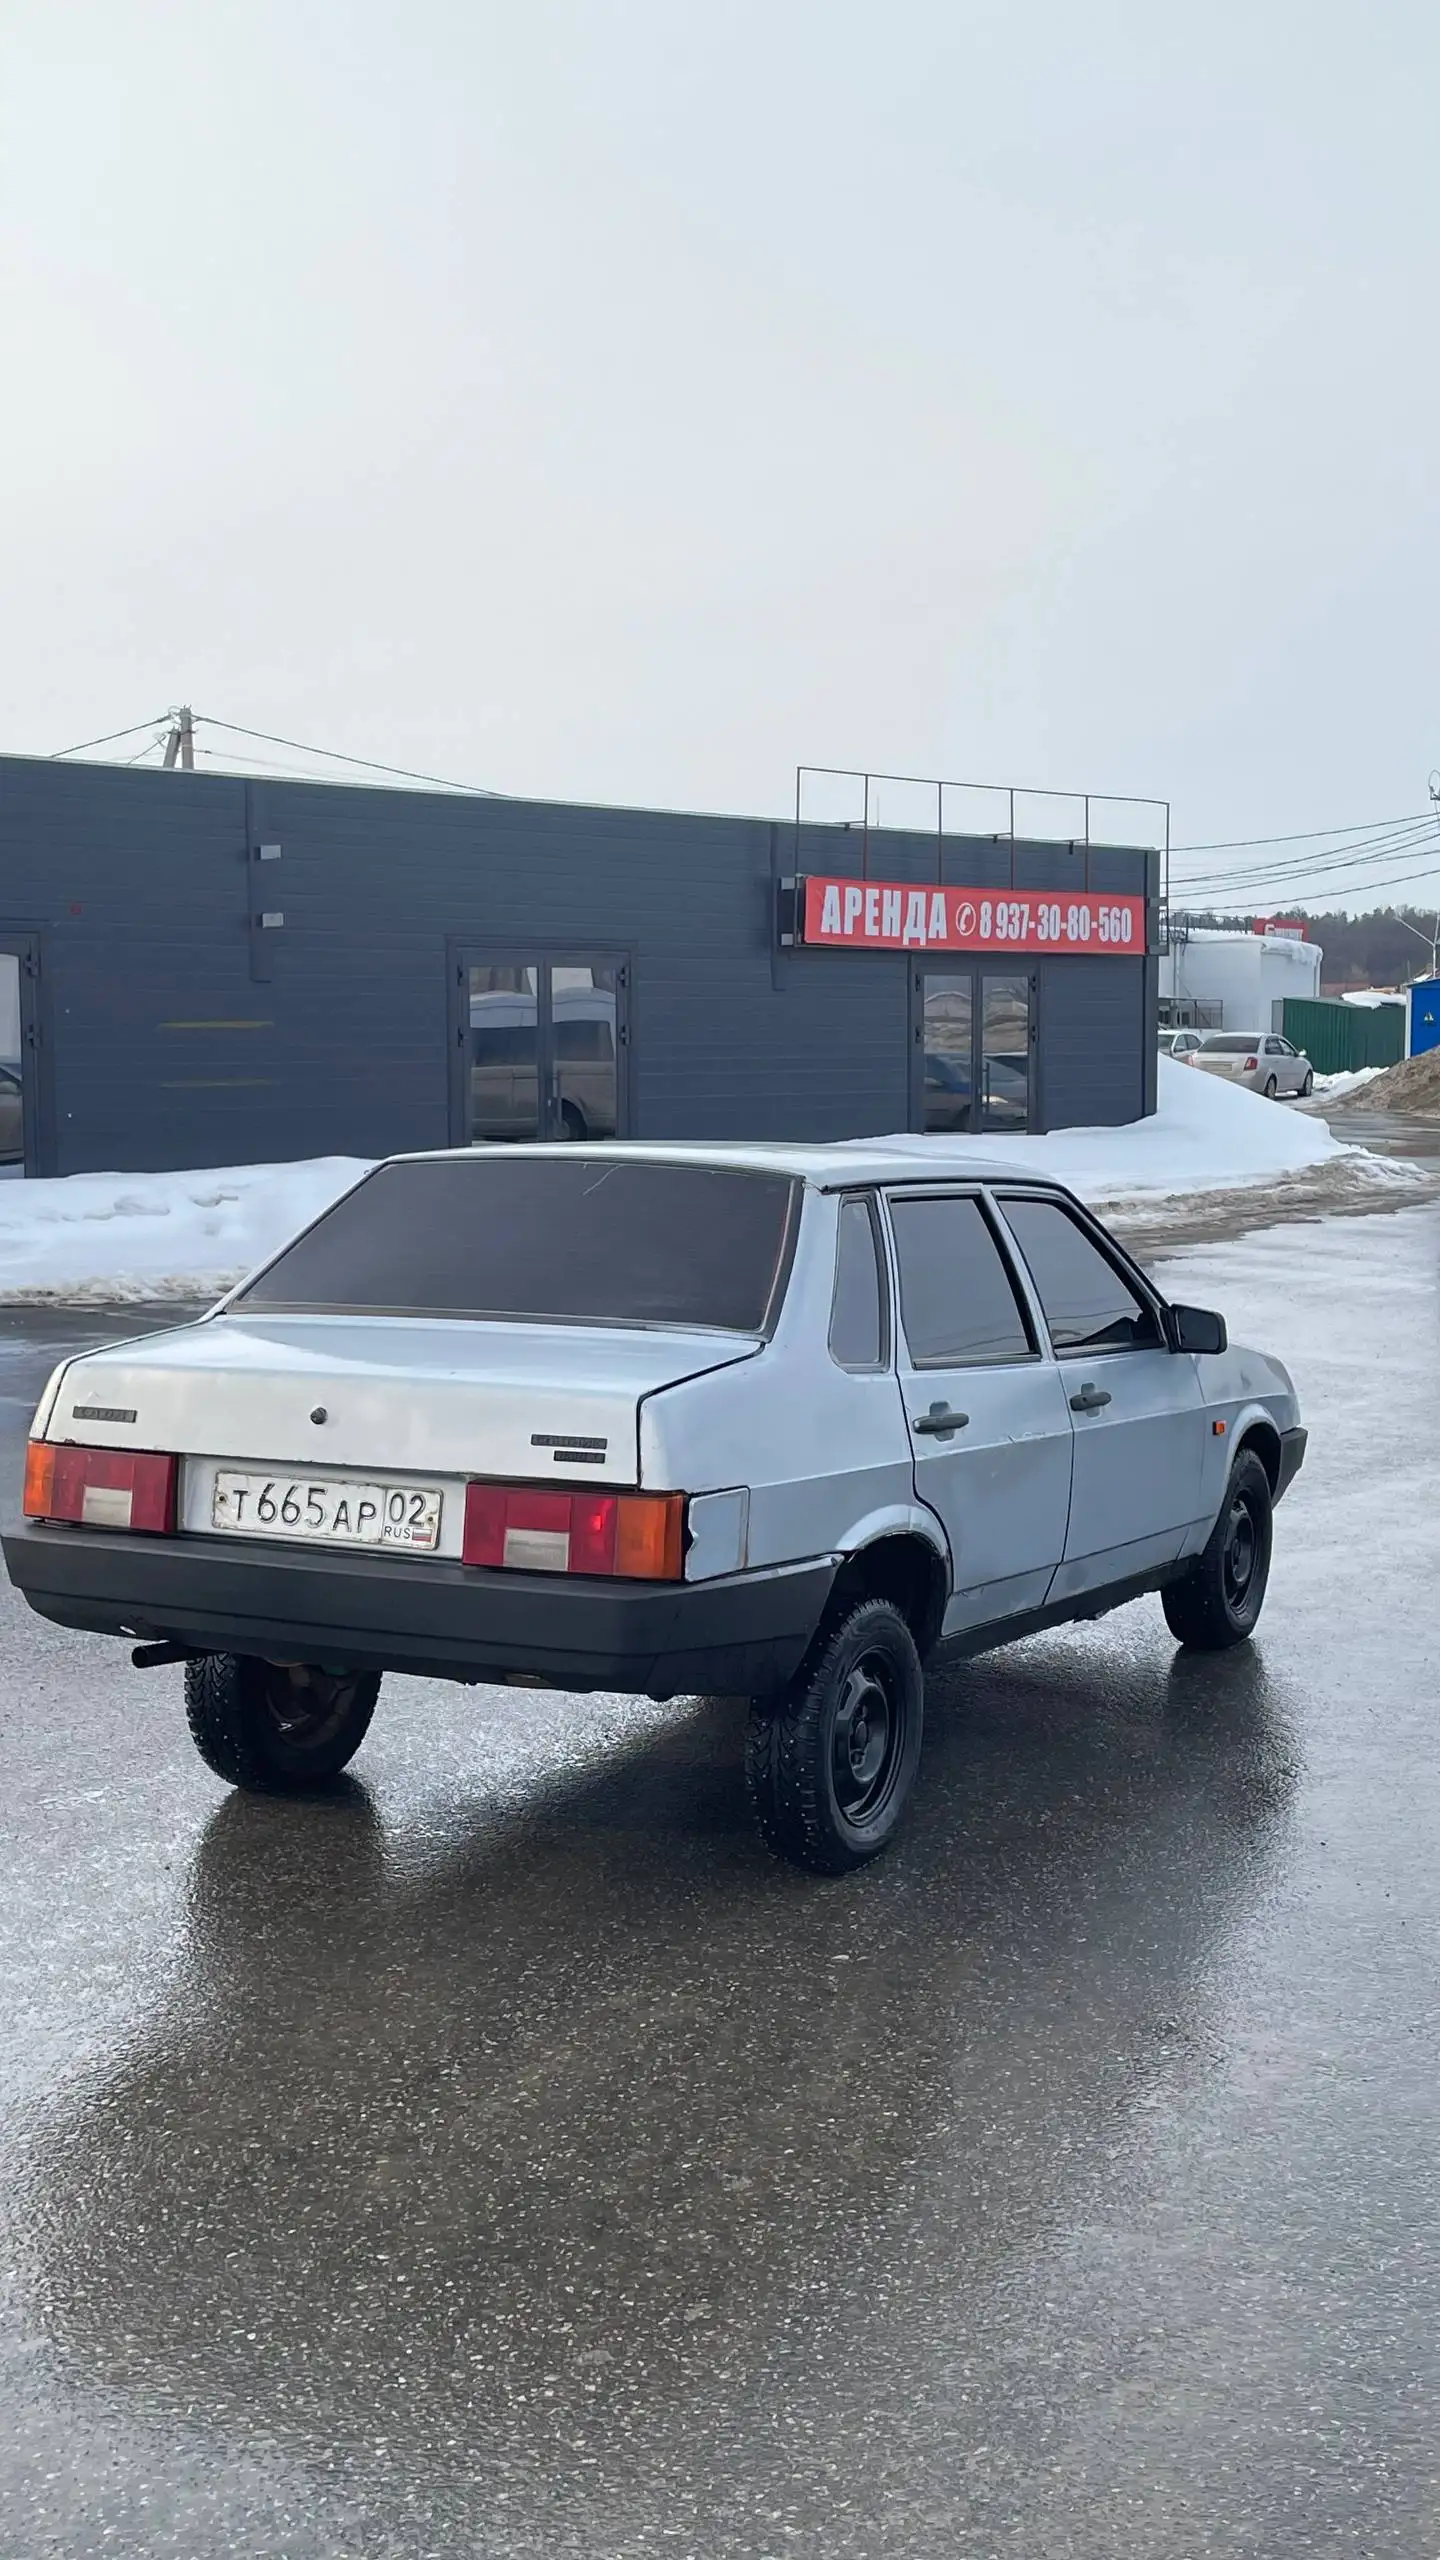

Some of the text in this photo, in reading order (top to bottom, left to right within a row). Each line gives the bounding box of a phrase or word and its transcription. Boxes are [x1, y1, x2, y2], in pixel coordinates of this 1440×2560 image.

[821, 885, 1133, 945] АРЕНДА 8 937-30-80-560
[389, 1493, 426, 1526] 02
[384, 1526, 411, 1539] RUS
